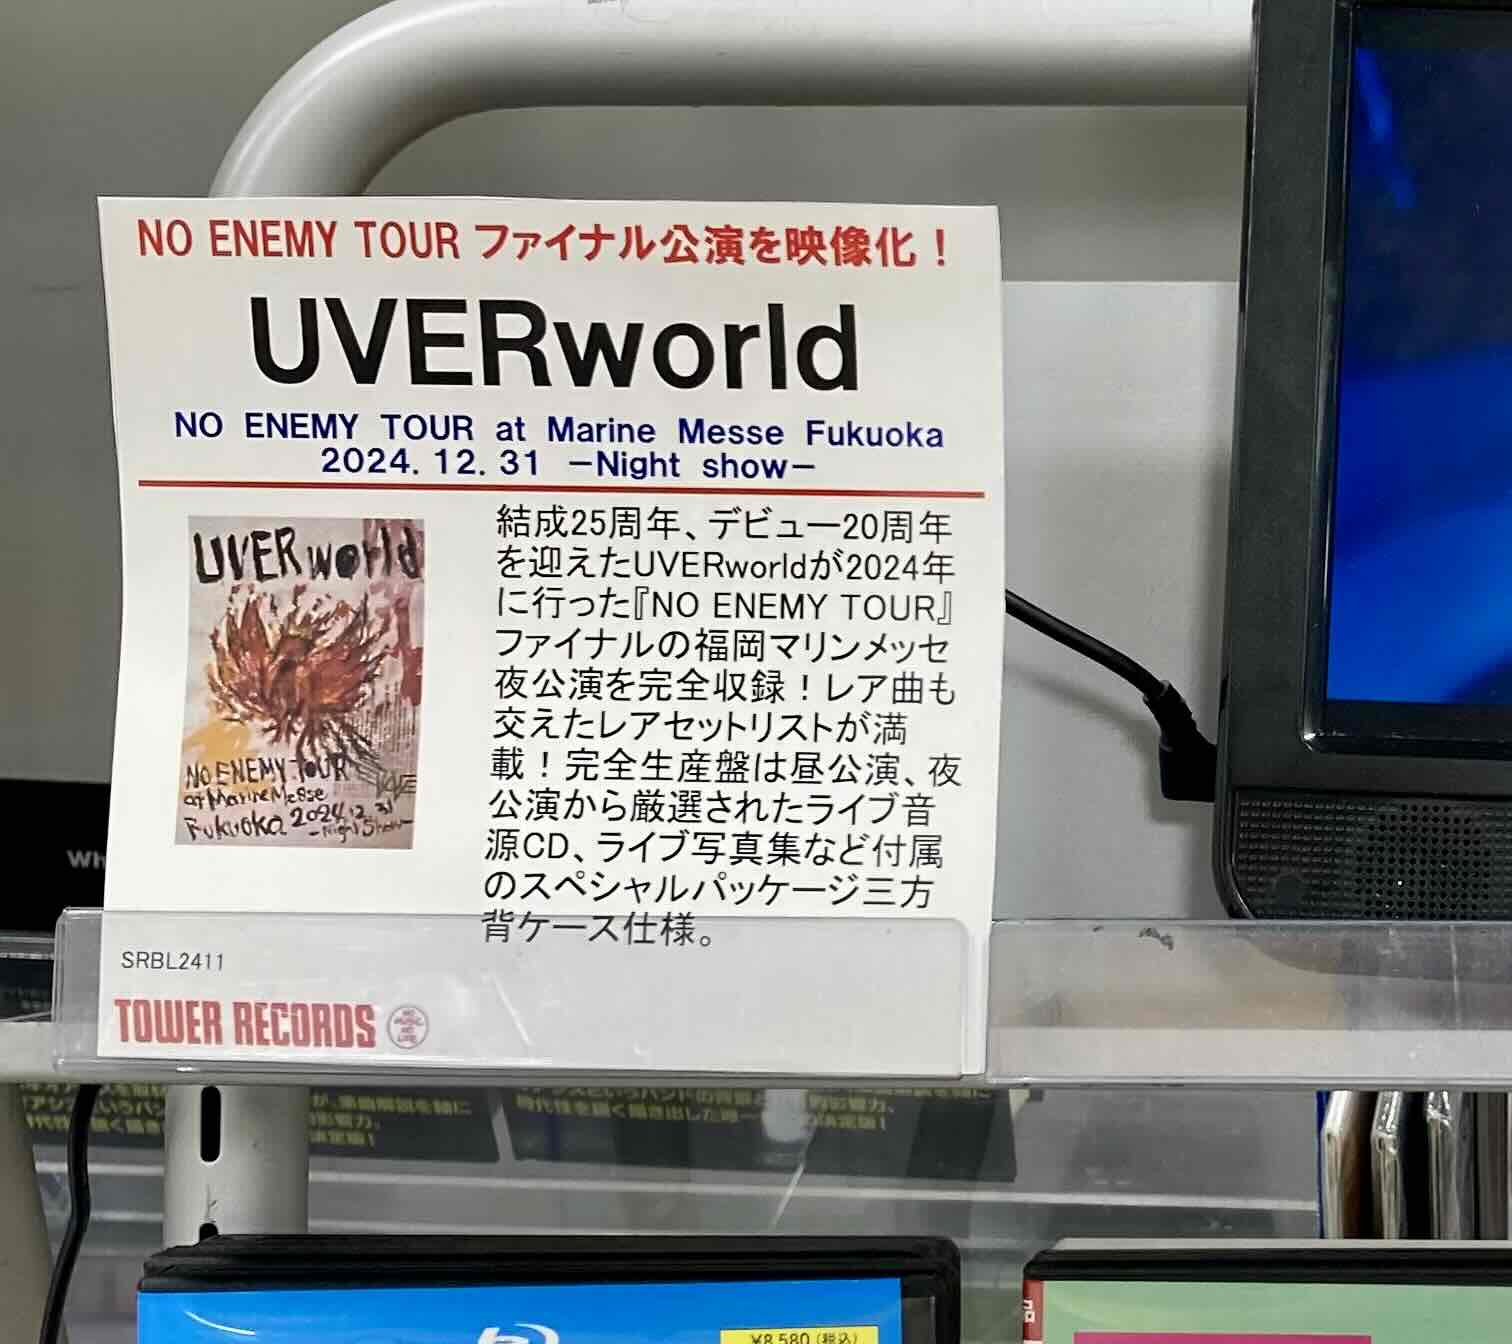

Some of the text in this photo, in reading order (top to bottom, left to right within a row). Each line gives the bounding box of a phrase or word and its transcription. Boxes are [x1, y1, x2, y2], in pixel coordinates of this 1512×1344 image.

[137, 218, 949, 269] NO ENEMY TOUR ファイナル公演を映像化！
[250, 295, 858, 392] UVERworld
[174, 412, 943, 450] NO ENEMY TOUR at Marine Messe Fukuoka
[497, 504, 953, 544] 結成25周年、デビュー20周年
[193, 525, 425, 584] UVERworld
[497, 545, 956, 584] を迎えたUVERworldが2024年
[713, 591, 827, 621] ENEMY
[841, 592, 953, 626] TOUR』
[495, 627, 950, 665] ファイナルの福岡マリンメッセ
[495, 667, 956, 706] 夜公演を完全収録！レア曲も
[493, 707, 908, 746] 交えたレアセットリストが満
[491, 748, 963, 789] 載！完全生産盤は昼公演、夜
[488, 788, 936, 827] 公演から厳選されたライブ音
[486, 828, 944, 869] 源CD、ライブ写真集など付属
[484, 869, 935, 909] のスペシャルパッケージ三方
[481, 910, 713, 947] 背ケース仕様。
[121, 950, 224, 972] SRBL2411
[113, 998, 223, 1045] TOWER
[232, 1002, 376, 1048] RECORDS
